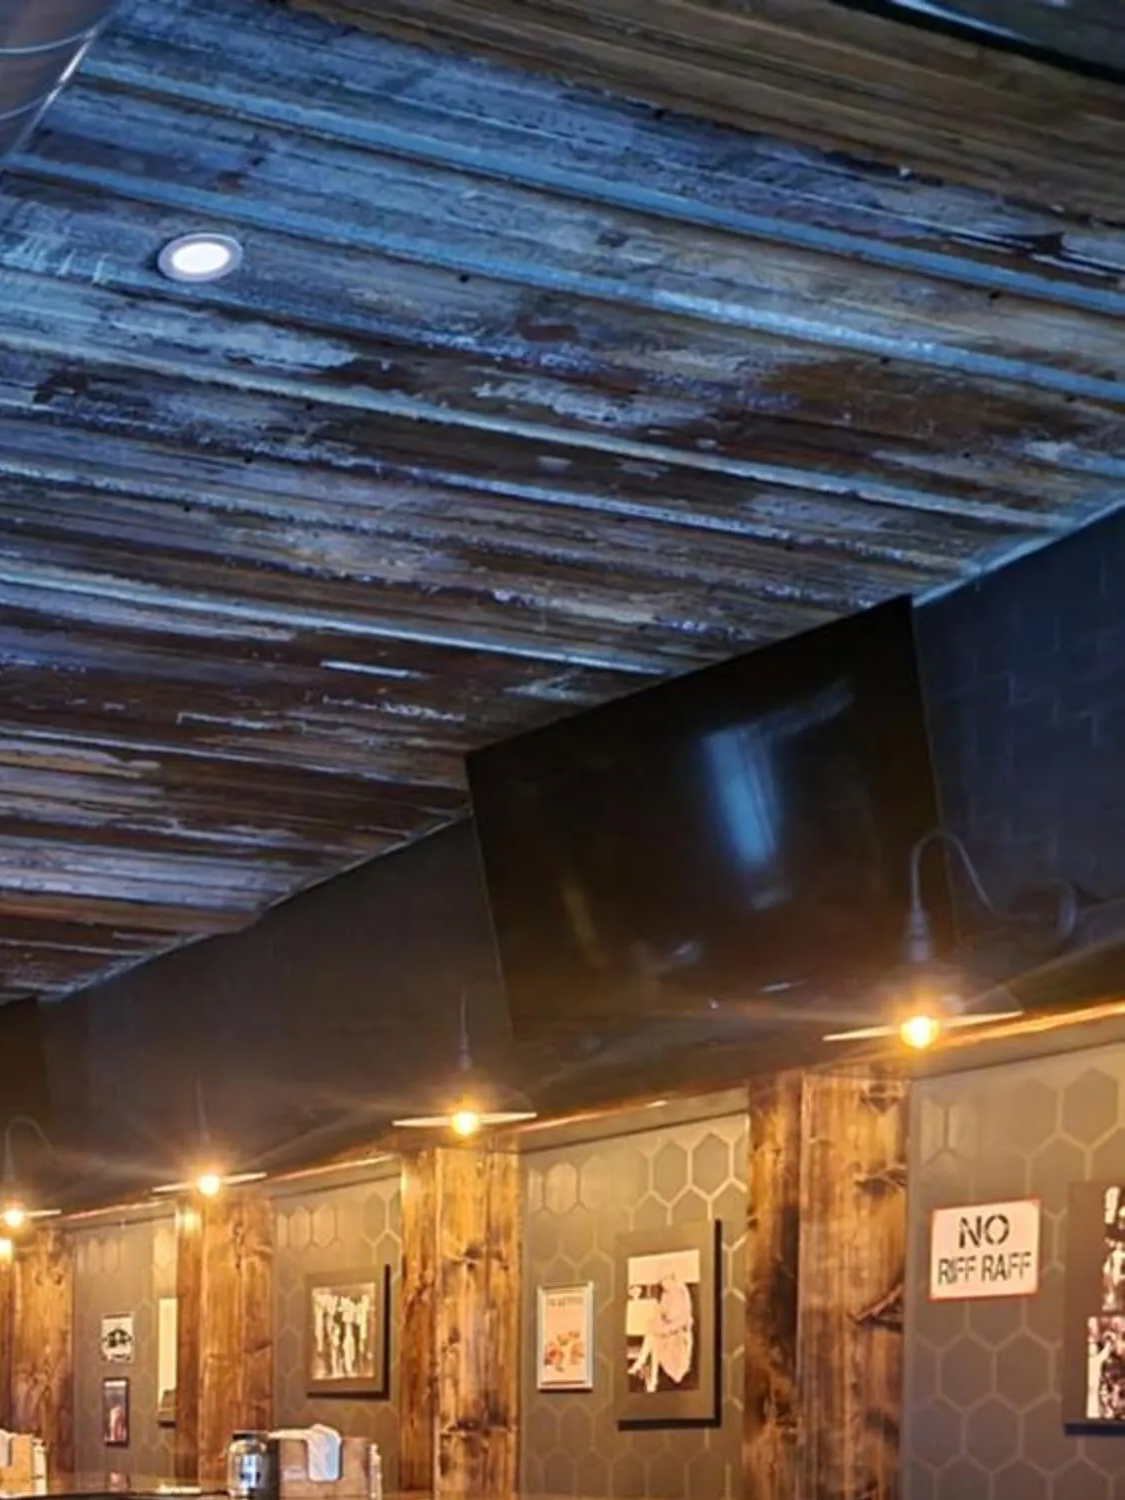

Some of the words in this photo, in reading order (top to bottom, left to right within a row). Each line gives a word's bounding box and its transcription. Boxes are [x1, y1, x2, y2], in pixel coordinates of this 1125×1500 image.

[958, 1214, 1010, 1248] NO
[938, 1256, 976, 1285] RIFF
[981, 1251, 1032, 1282] RAFF
